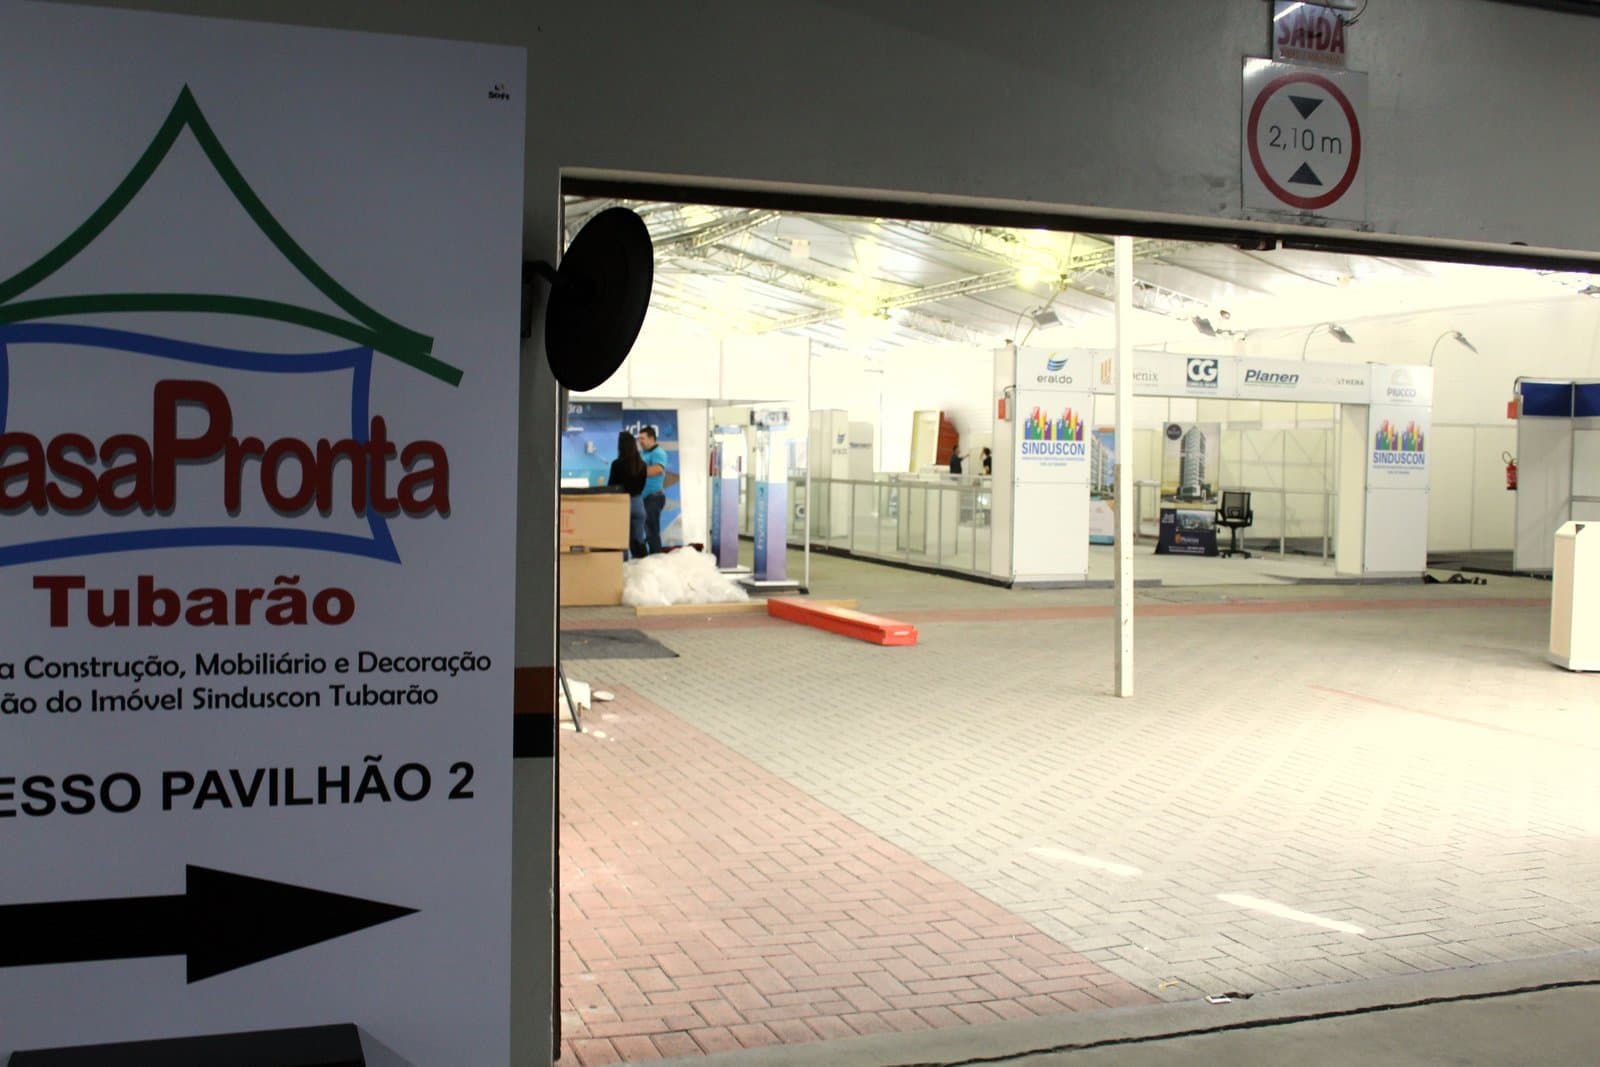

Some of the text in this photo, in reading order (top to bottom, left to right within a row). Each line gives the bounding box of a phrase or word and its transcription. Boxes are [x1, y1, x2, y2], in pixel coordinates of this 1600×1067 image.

[1269, 126, 1342, 154] 2,10 m
[1036, 374, 1073, 385] eraldo
[1245, 369, 1299, 384] Planen
[1022, 442, 1085, 456] SINDUSCON
[1373, 451, 1425, 465] SINDUSCON
[33, 575, 355, 628] Tubarão
[24, 655, 186, 682] Construção,
[195, 652, 327, 676] Mobiliário
[334, 657, 349, 673] e
[358, 651, 492, 677] Decoração
[1, 684, 438, 714] ão do Imóvel Sinduscon Tubarão
[162, 755, 431, 811] PAVILHÃO
[448, 761, 474, 800] 2
